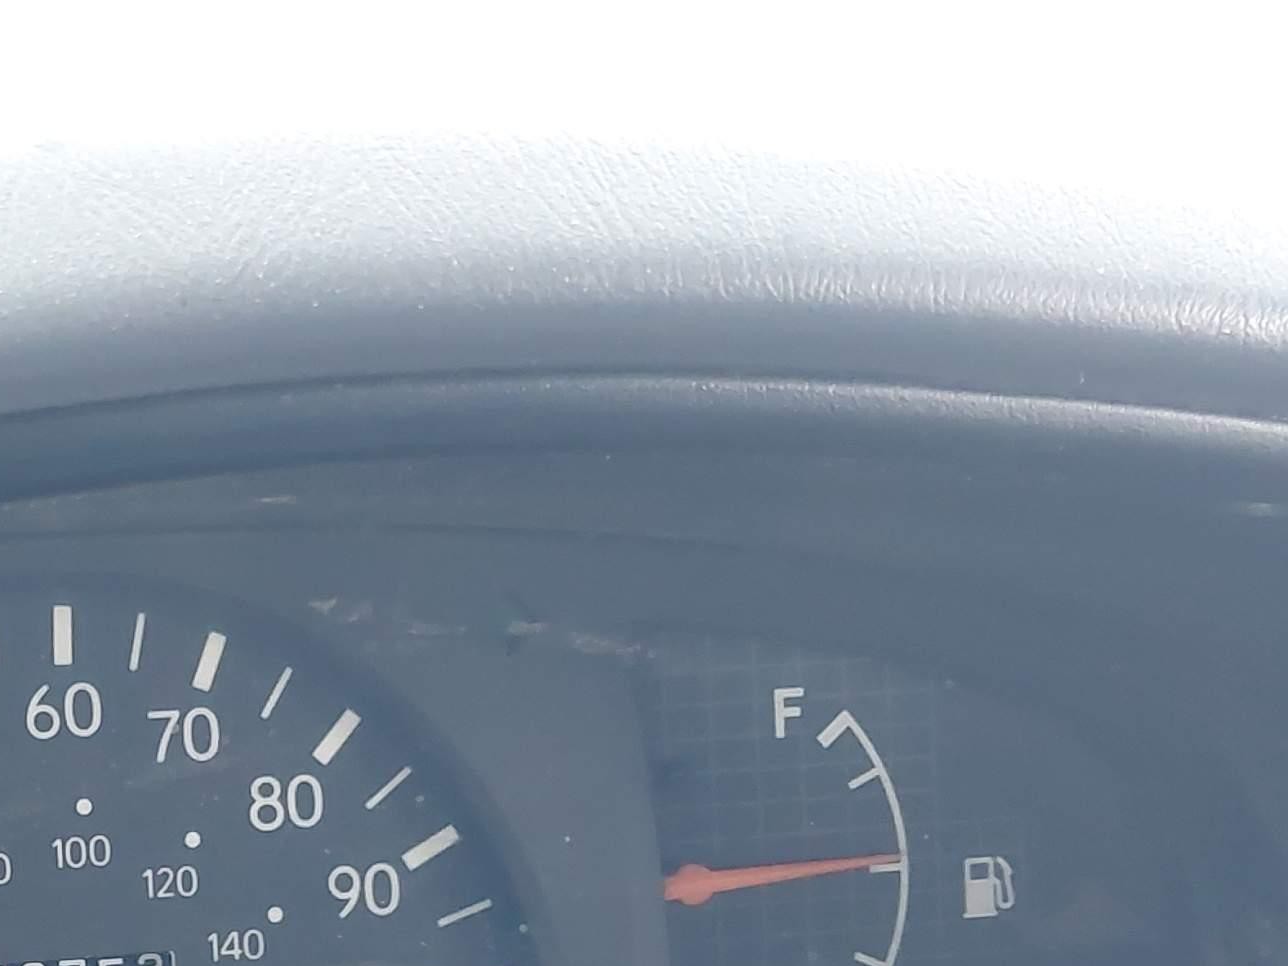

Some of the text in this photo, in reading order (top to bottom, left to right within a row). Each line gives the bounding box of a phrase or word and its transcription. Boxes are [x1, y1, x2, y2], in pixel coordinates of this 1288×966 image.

[26, 682, 102, 740] 60
[147, 706, 221, 763] 70
[772, 687, 805, 738] F
[248, 773, 324, 831] 80
[52, 835, 111, 869] 100
[141, 865, 198, 899] 120
[327, 862, 401, 919] 90
[207, 928, 265, 962] 140
